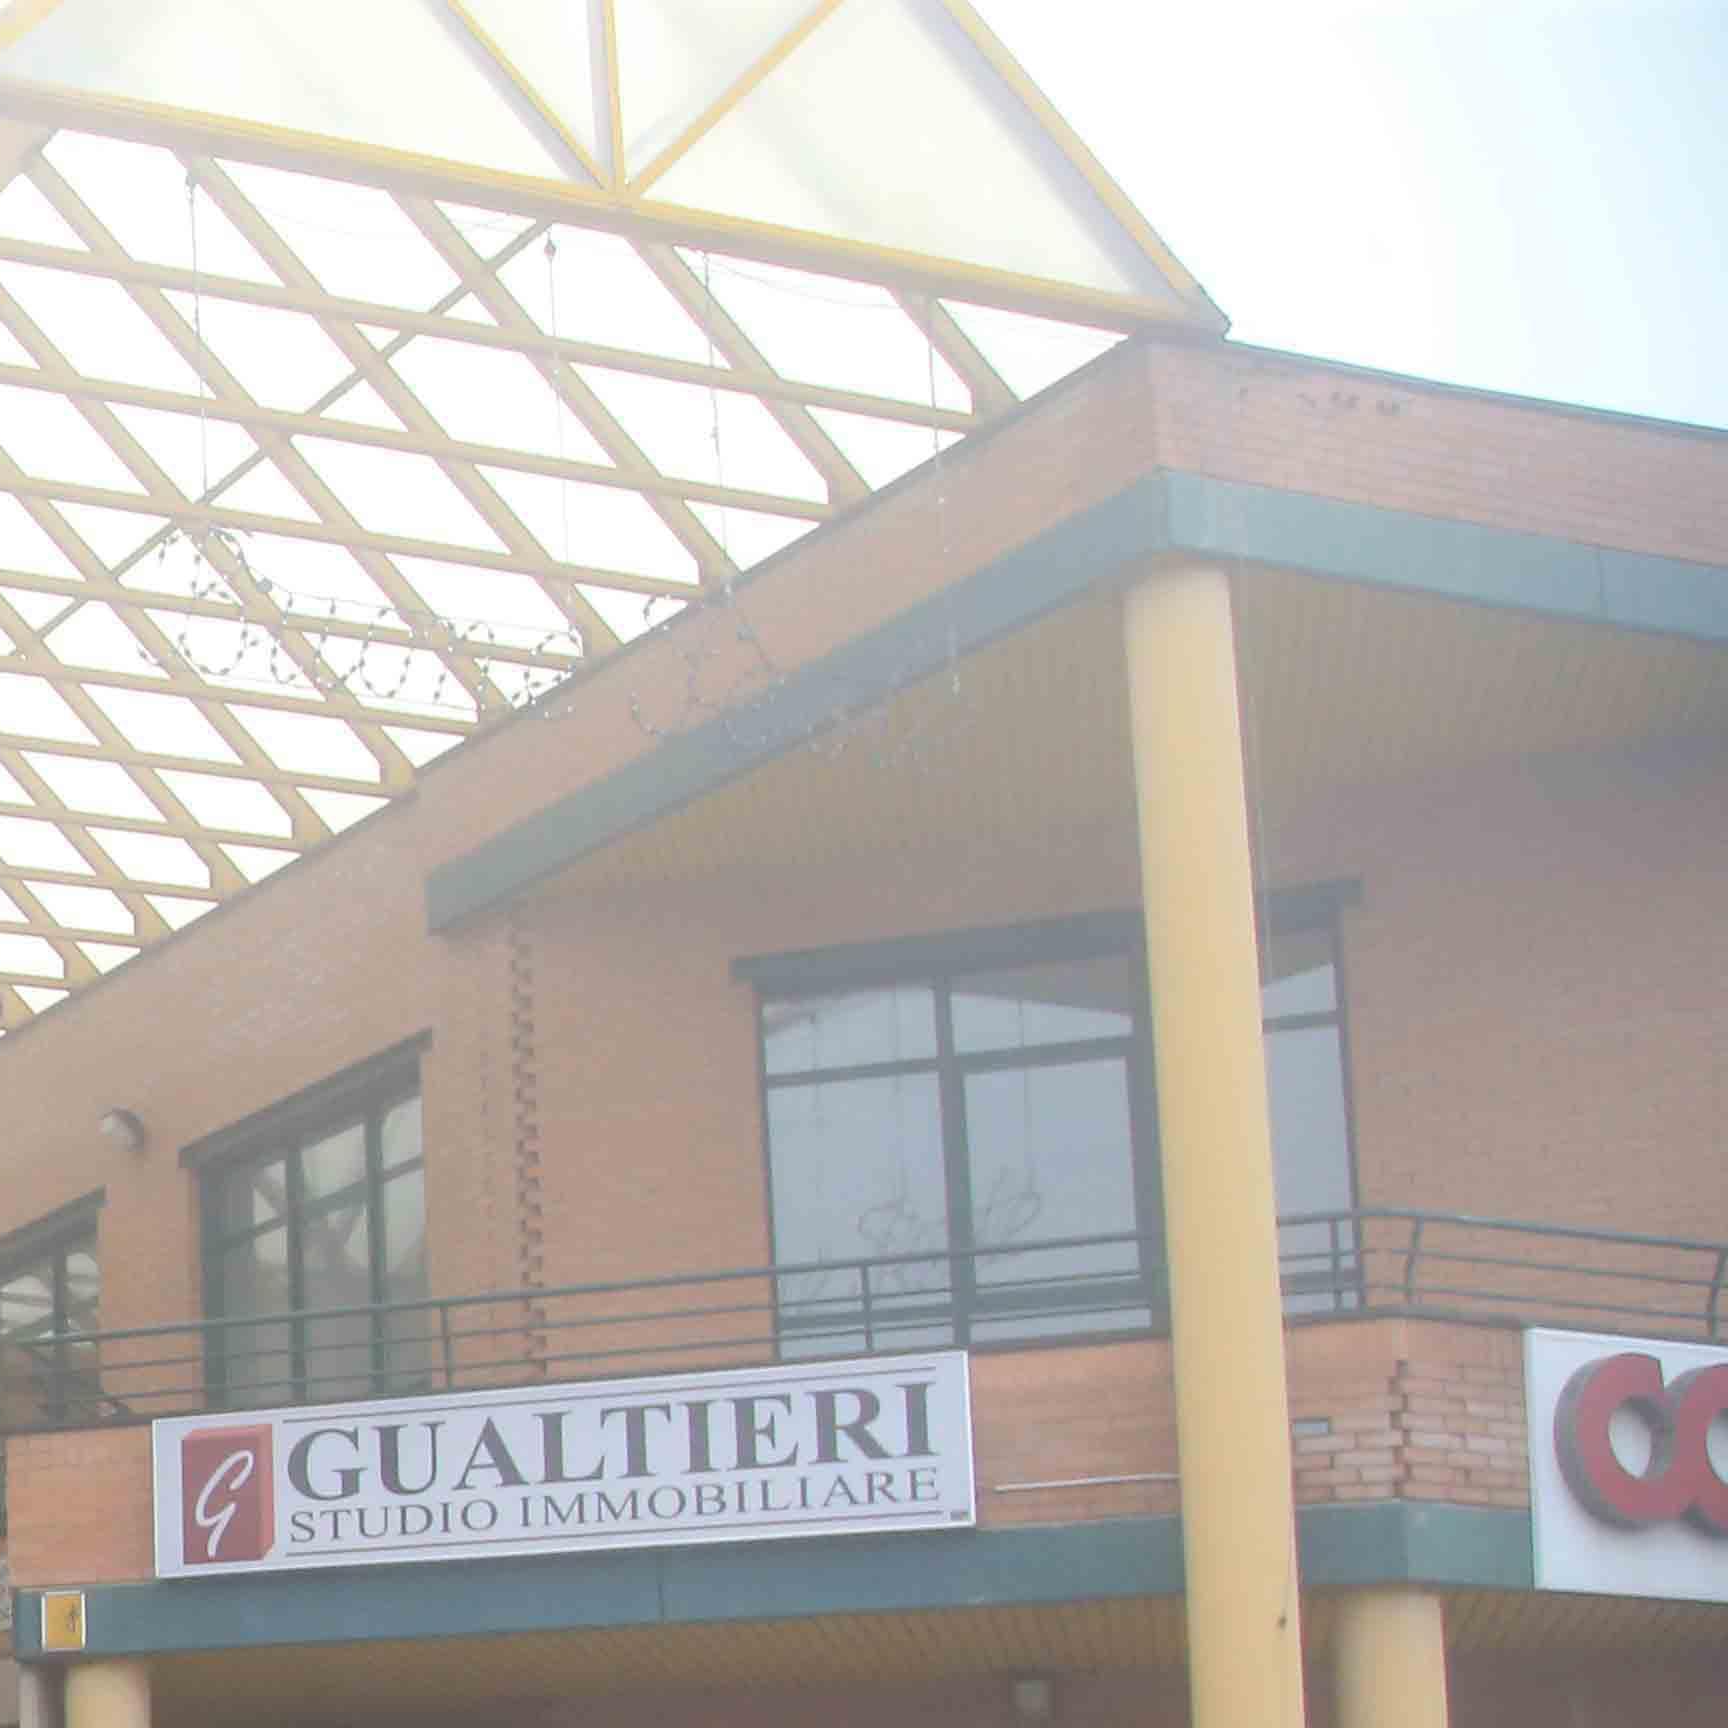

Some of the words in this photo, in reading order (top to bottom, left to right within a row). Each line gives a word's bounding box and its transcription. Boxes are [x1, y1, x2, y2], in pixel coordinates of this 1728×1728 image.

[287, 1381, 940, 1502] GUALTIERI
[290, 1498, 499, 1543] STUDIO
[519, 1466, 942, 1528] IMMOBILIARE
